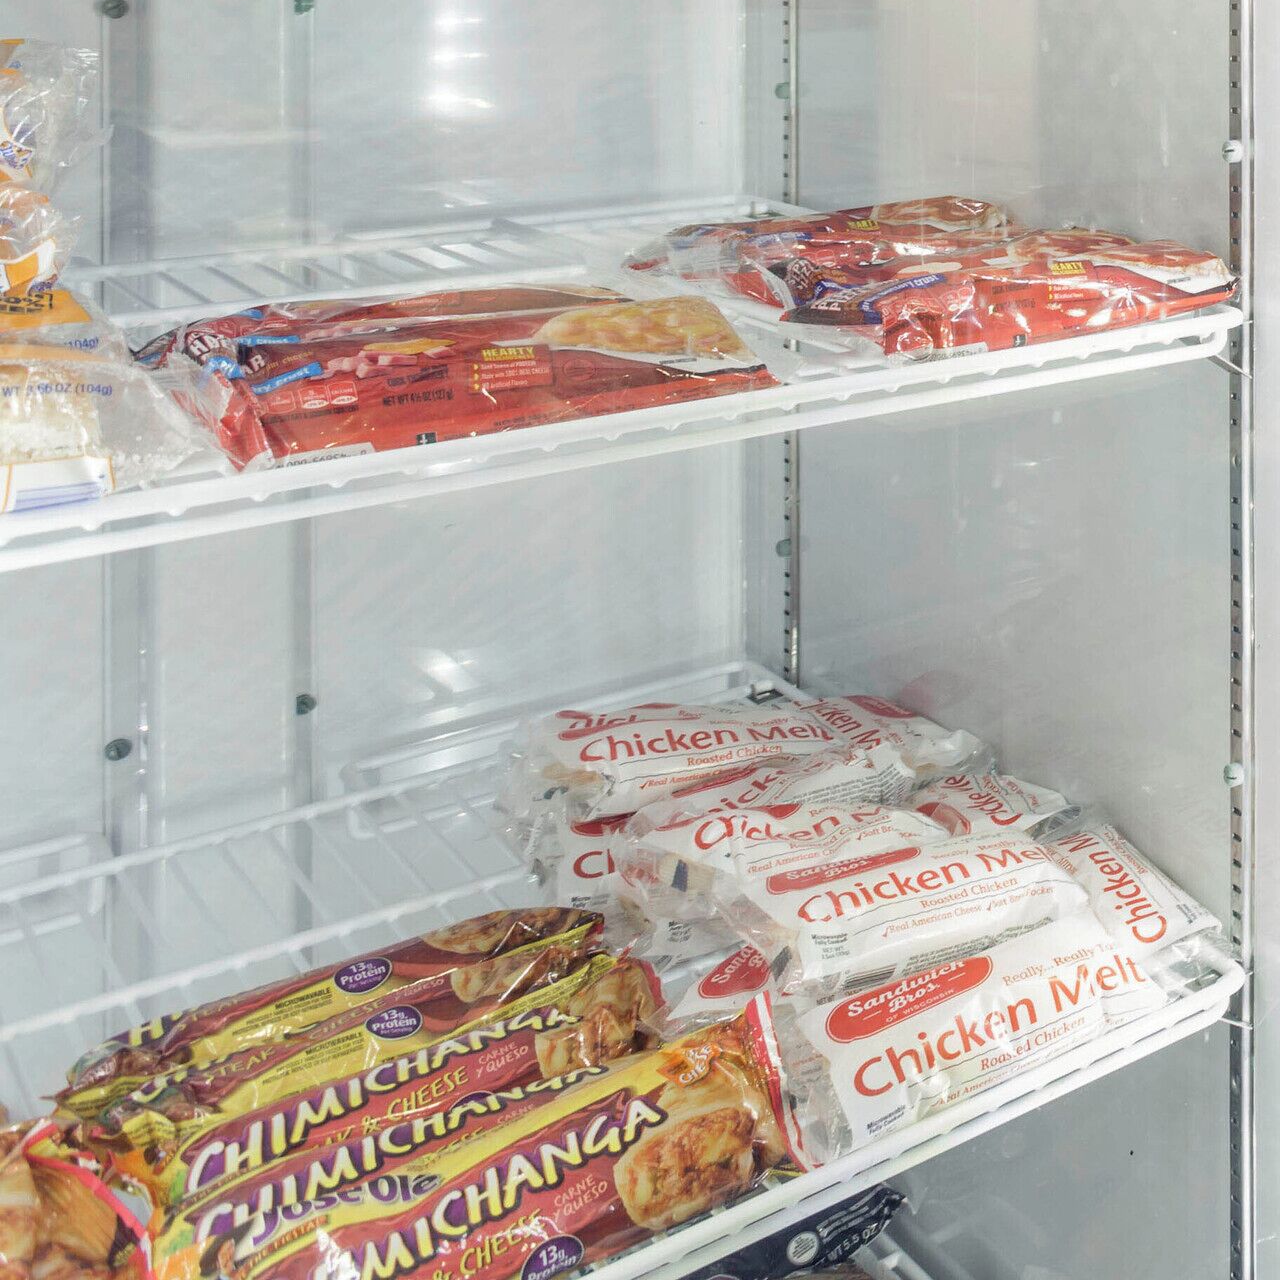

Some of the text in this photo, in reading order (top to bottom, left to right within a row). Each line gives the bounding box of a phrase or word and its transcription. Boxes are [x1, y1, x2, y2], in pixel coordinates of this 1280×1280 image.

[580, 728, 739, 763] Chicken
[687, 750, 733, 766] Roasted
[798, 861, 971, 923] Chicken
[976, 845, 1049, 873] Mel
[920, 876, 1019, 909] Roasted Chicken
[1088, 850, 1168, 943] Chicken
[906, 909, 952, 931] American
[340, 965, 386, 986] Protein
[274, 987, 332, 1010] MICROWAVABLE
[888, 983, 941, 1015] Bros.
[902, 988, 956, 1017] WISCONSIN
[371, 1017, 417, 1032] Protein
[853, 953, 1147, 1098] Chicken Melt
[1033, 1014, 1086, 1048] Chicken
[305, 1031, 364, 1056] MICROWAVABLE
[479, 1040, 516, 1065] CARNE
[483, 1046, 529, 1075] QUESO
[186, 1008, 583, 1195] CHIMICHANGA
[387, 1065, 469, 1122] CHEESE
[350, 1099, 668, 1280] MICHANGA
[554, 1174, 596, 1206] CARNE
[563, 1180, 609, 1214] QUESO
[460, 1207, 548, 1276] CHEESE
